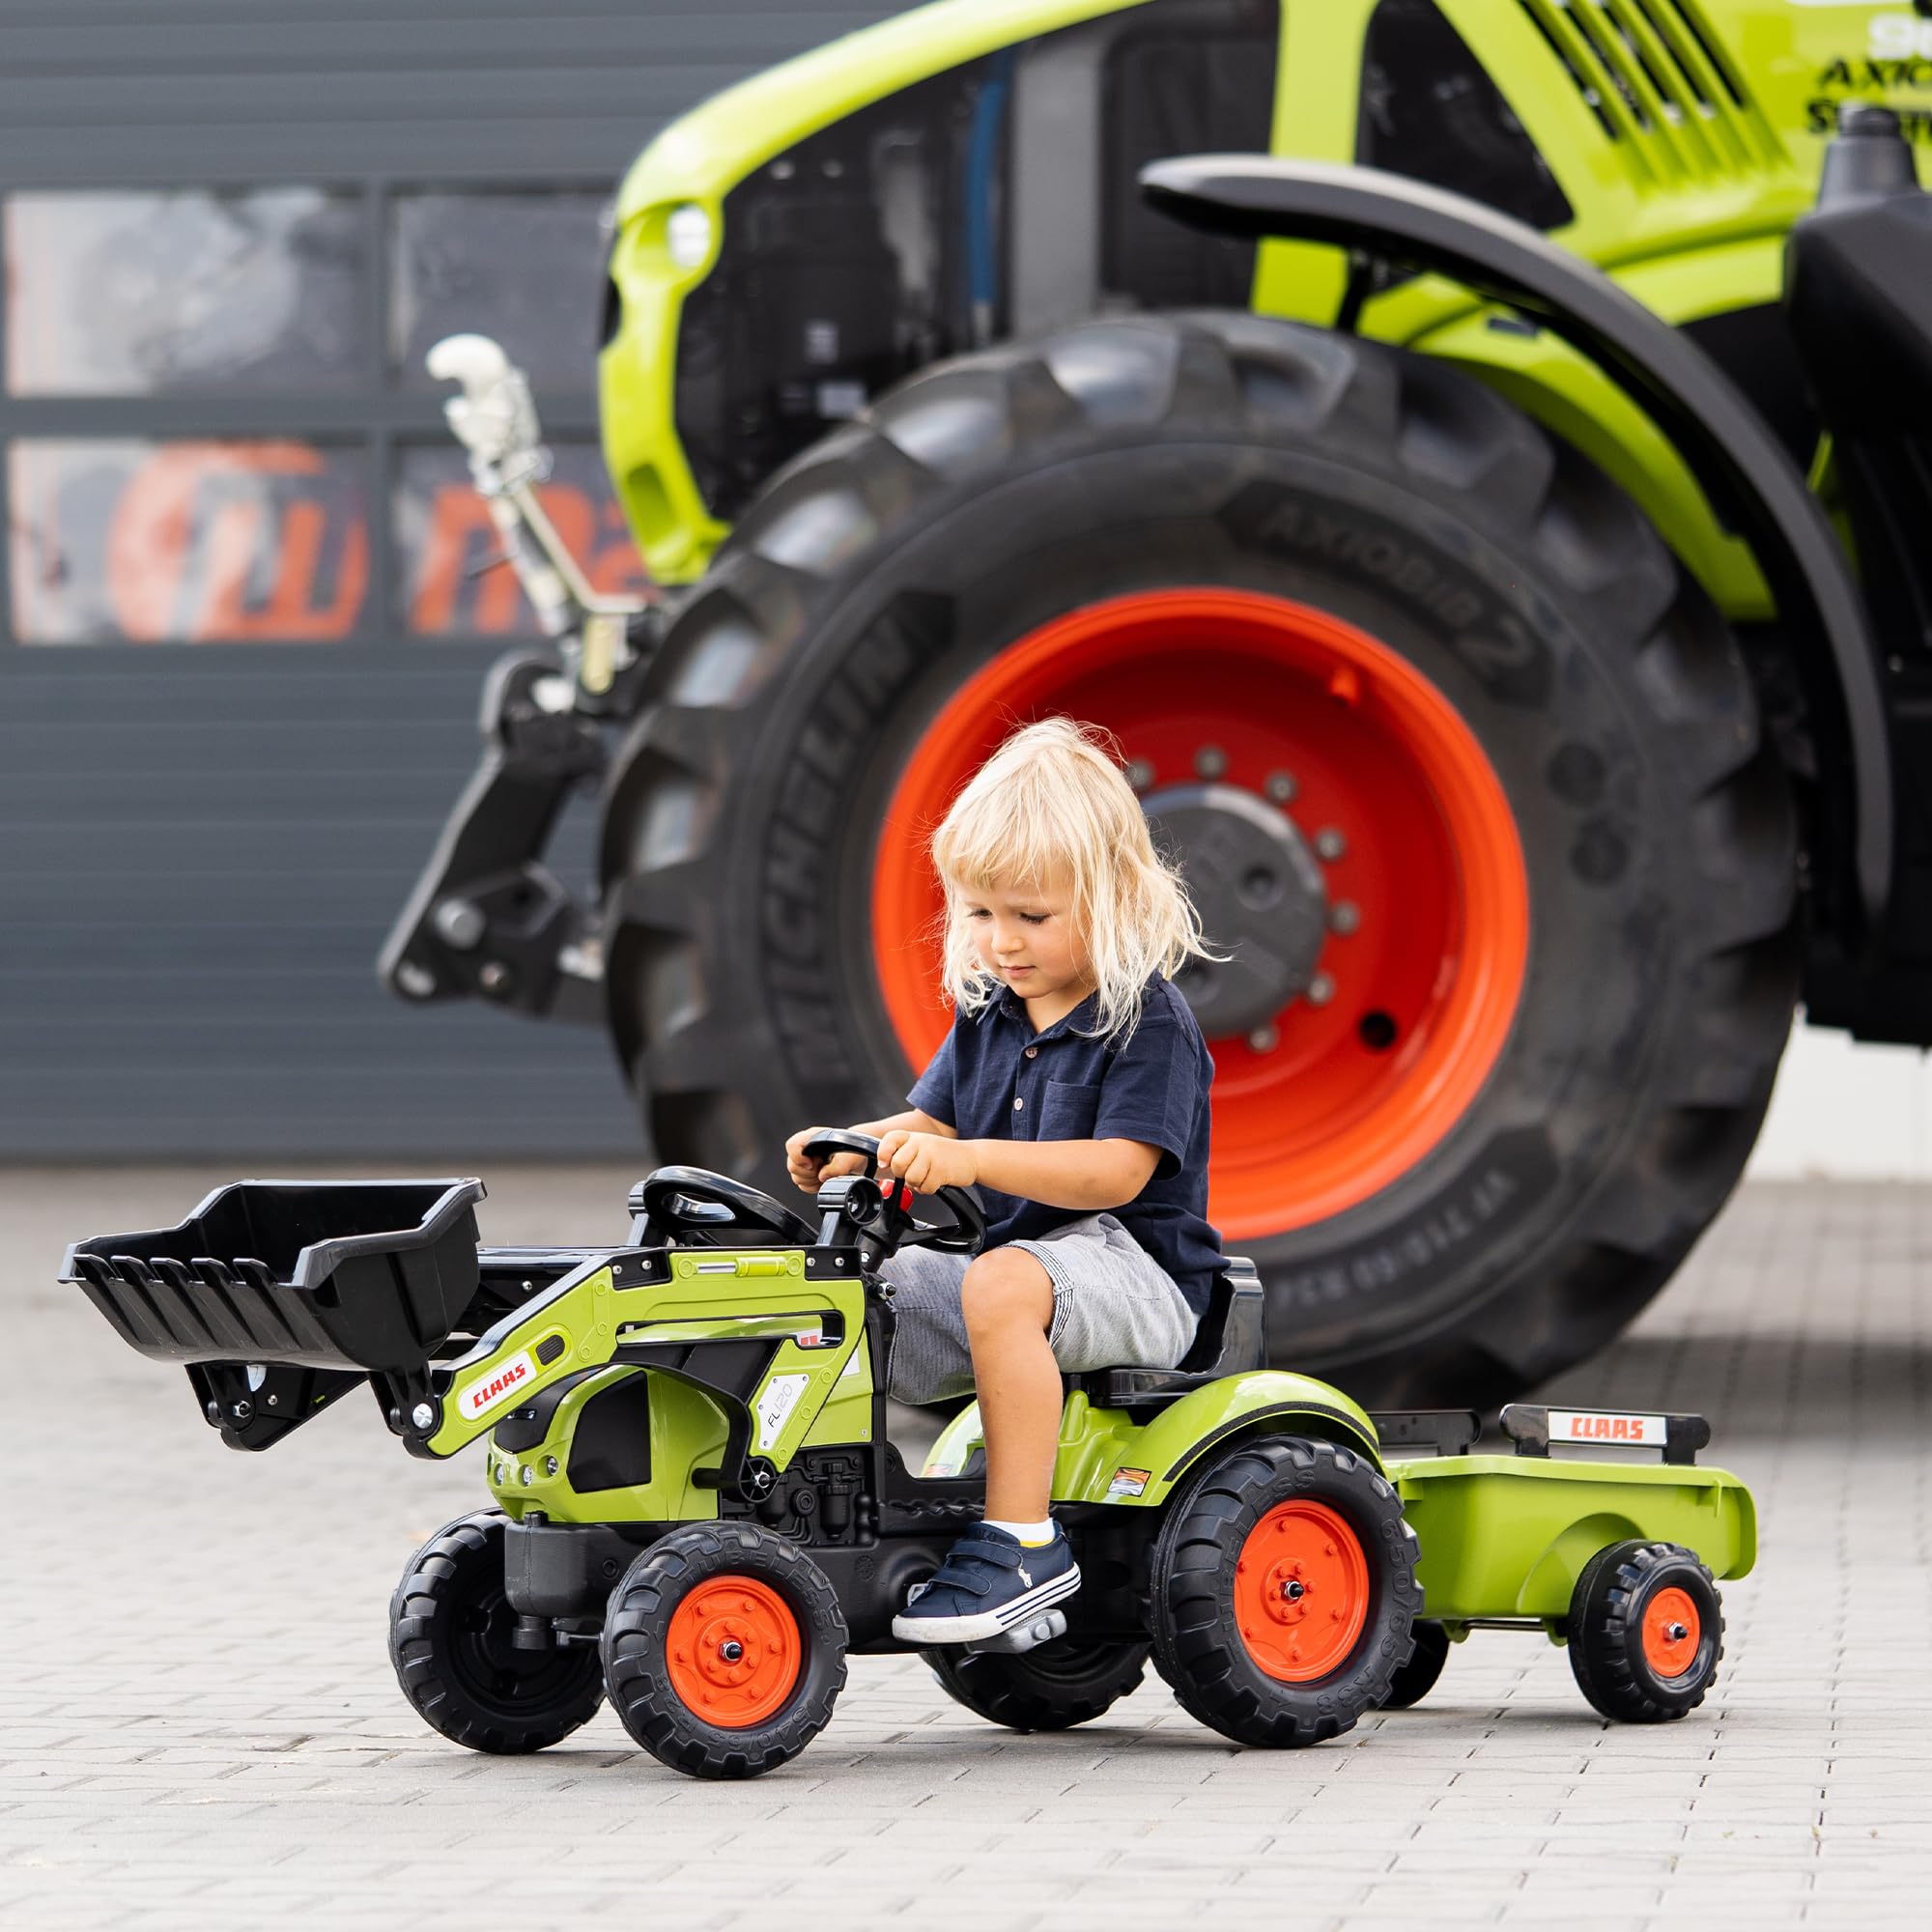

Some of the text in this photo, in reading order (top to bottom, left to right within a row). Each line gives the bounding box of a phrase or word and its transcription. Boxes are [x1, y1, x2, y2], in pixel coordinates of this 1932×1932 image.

[768, 611, 918, 1080] MICHELIN
[472, 1362, 526, 1408] CLAAS
[1571, 1417, 1644, 1440] CLAAS
[679, 1548, 832, 1632] TUBELESS
[1379, 1518, 1410, 1659] 650/65
[709, 1709, 811, 1751] 540/65
